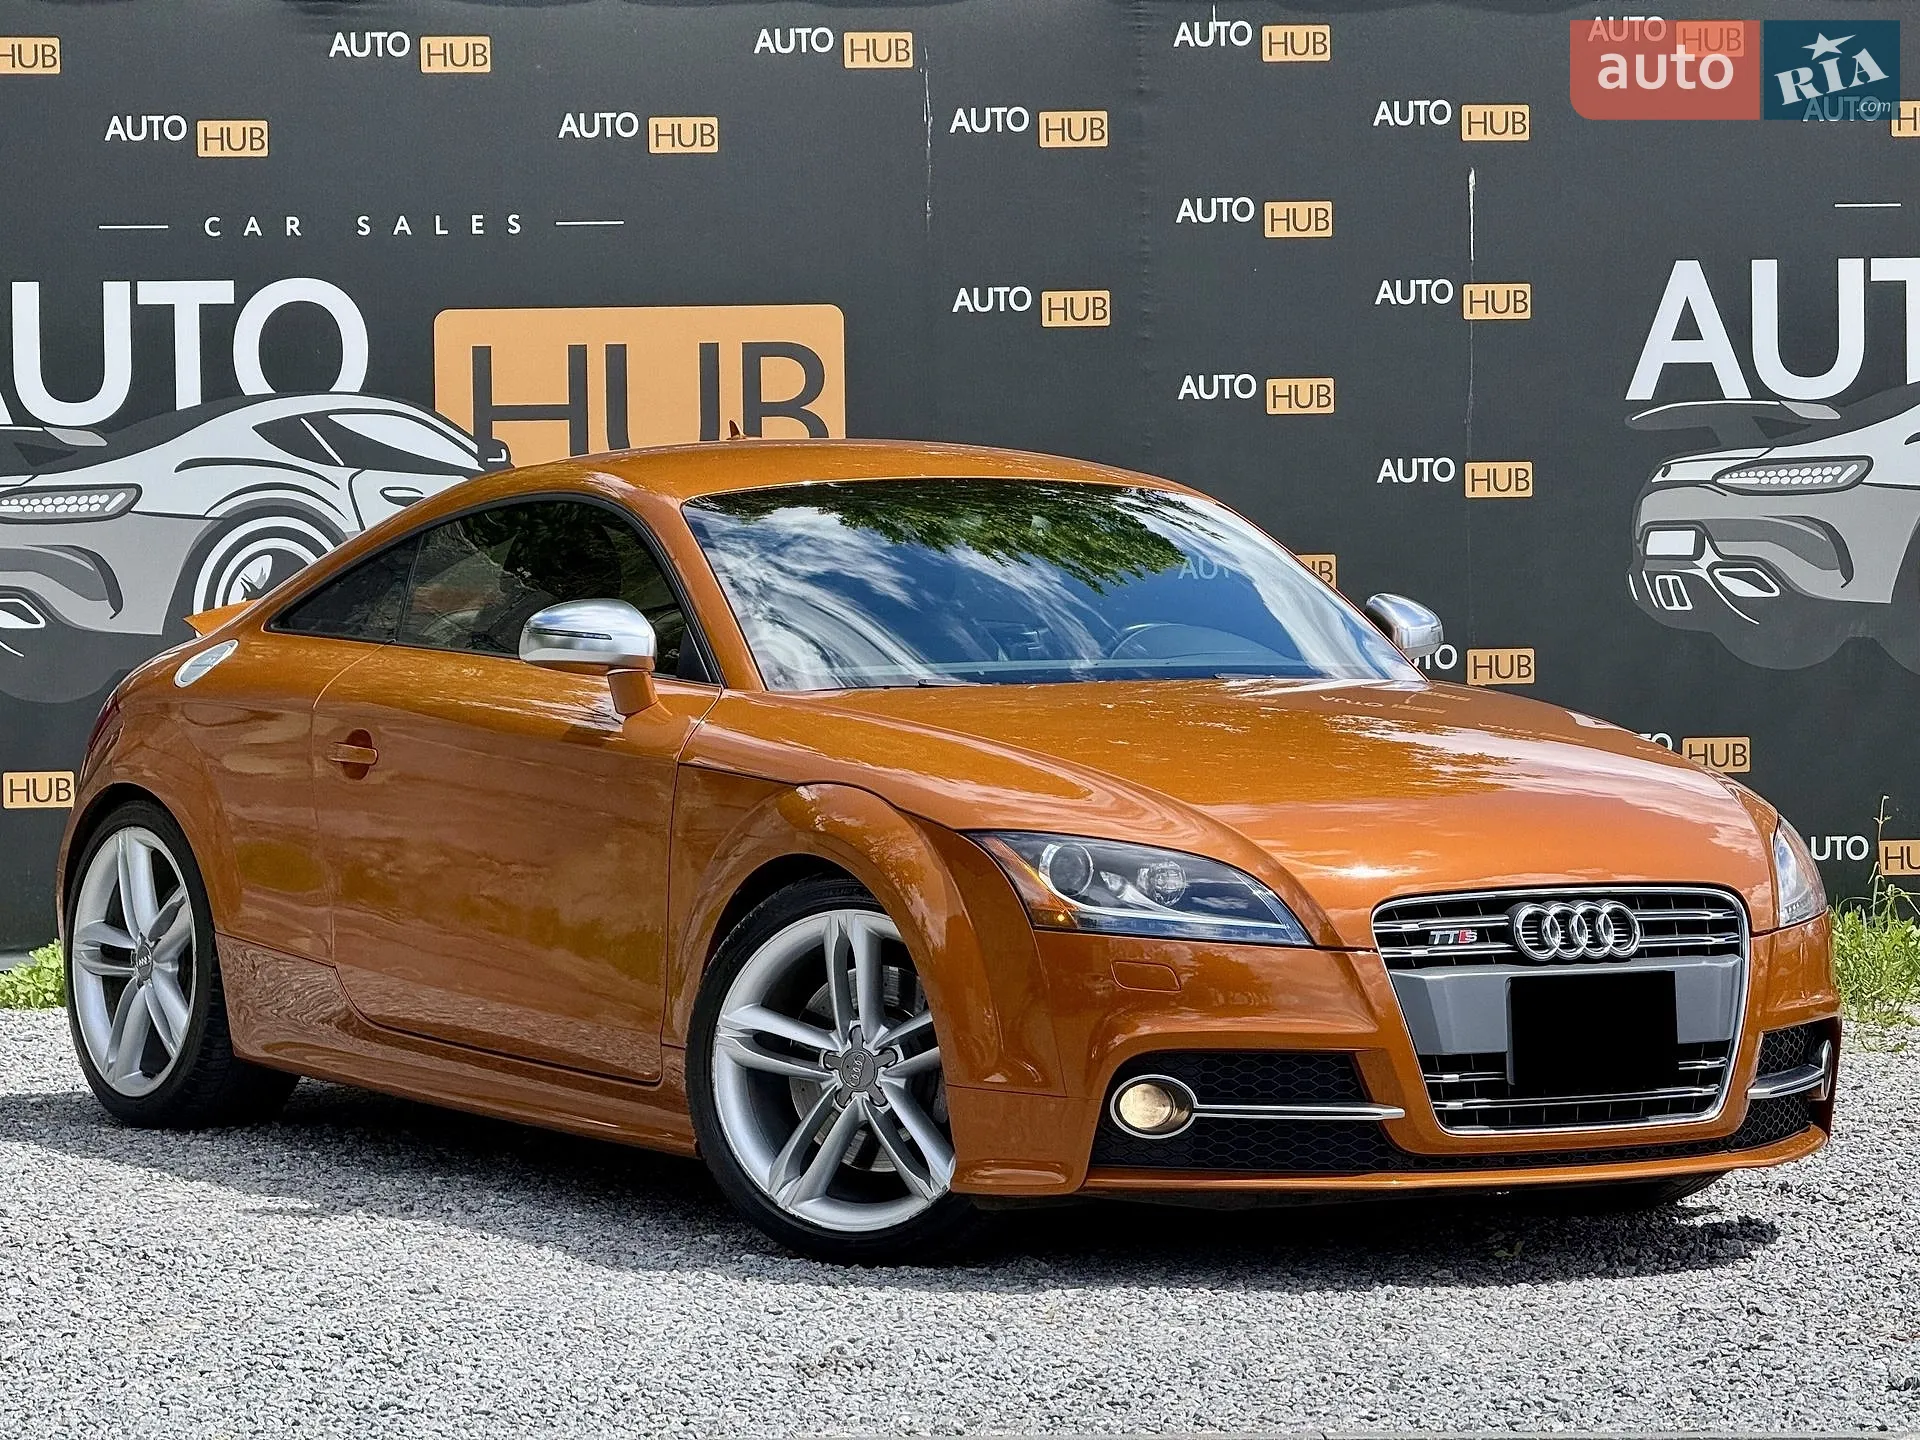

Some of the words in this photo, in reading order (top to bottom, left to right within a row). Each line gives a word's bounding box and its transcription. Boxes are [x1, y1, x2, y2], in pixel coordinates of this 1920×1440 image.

[329, 32, 410, 58] AUTO
[427, 43, 487, 67] HUB
[754, 27, 834, 53] AUTO
[851, 39, 909, 62] HUB
[1174, 21, 1252, 47] AUTO
[1269, 32, 1327, 56] HUB
[105, 115, 187, 141] AUTO
[204, 127, 265, 151] HUB
[558, 112, 638, 138] AUTO
[656, 124, 715, 147] HUB
[950, 107, 1029, 133] AUTO
[1046, 118, 1105, 142] HUB
[1373, 100, 1451, 126] AUTO
[1468, 111, 1526, 135] HUB
[205, 217, 301, 236] CAR
[358, 215, 520, 235] SALES
[1176, 197, 1254, 223] AUTO
[1271, 208, 1329, 232] HUB
[952, 287, 1031, 312] AUTO
[1048, 297, 1107, 321] HUB
[1375, 279, 1453, 304] AUTO
[1470, 290, 1528, 314] HUB
[0, 278, 368, 425] UTO
[1178, 374, 1256, 399] AUTO
[1273, 384, 1331, 408] HUB
[1377, 458, 1455, 483] AUTO
[1472, 468, 1529, 492] HUB
[1473, 655, 1531, 679] HUB
[9, 778, 71, 802] HUB
[1811, 836, 1869, 860] UTO
[1885, 846, 1920, 870] HU
